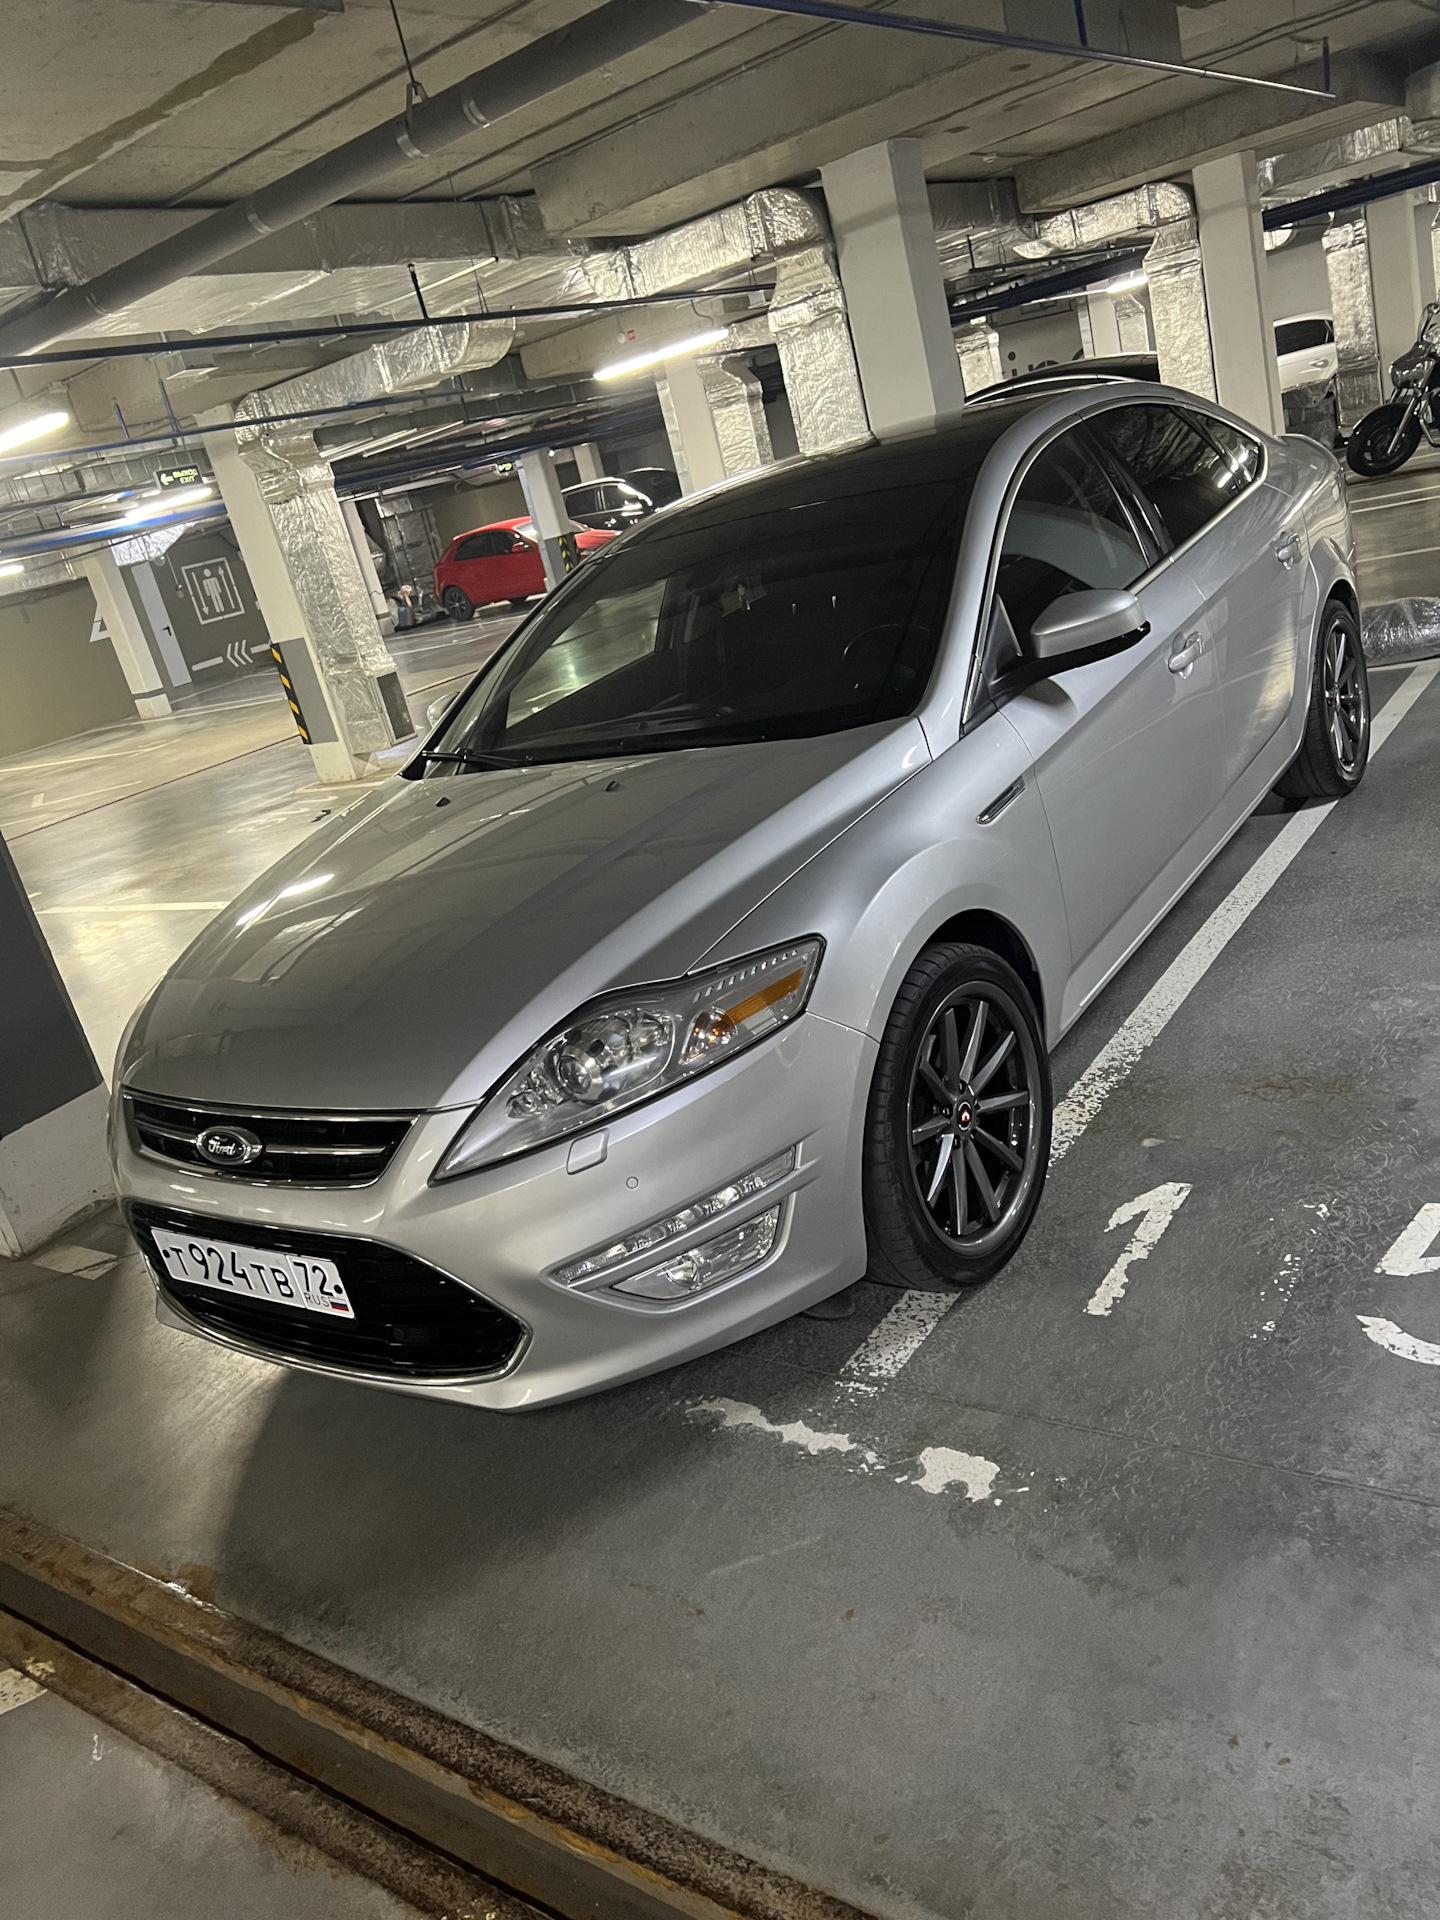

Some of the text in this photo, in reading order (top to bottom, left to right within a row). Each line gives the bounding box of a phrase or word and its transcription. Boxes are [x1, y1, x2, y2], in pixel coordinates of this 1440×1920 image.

[180, 476, 195, 484] EXIT
[208, 1139, 236, 1156] Ford
[304, 1292, 331, 1308] RUS
